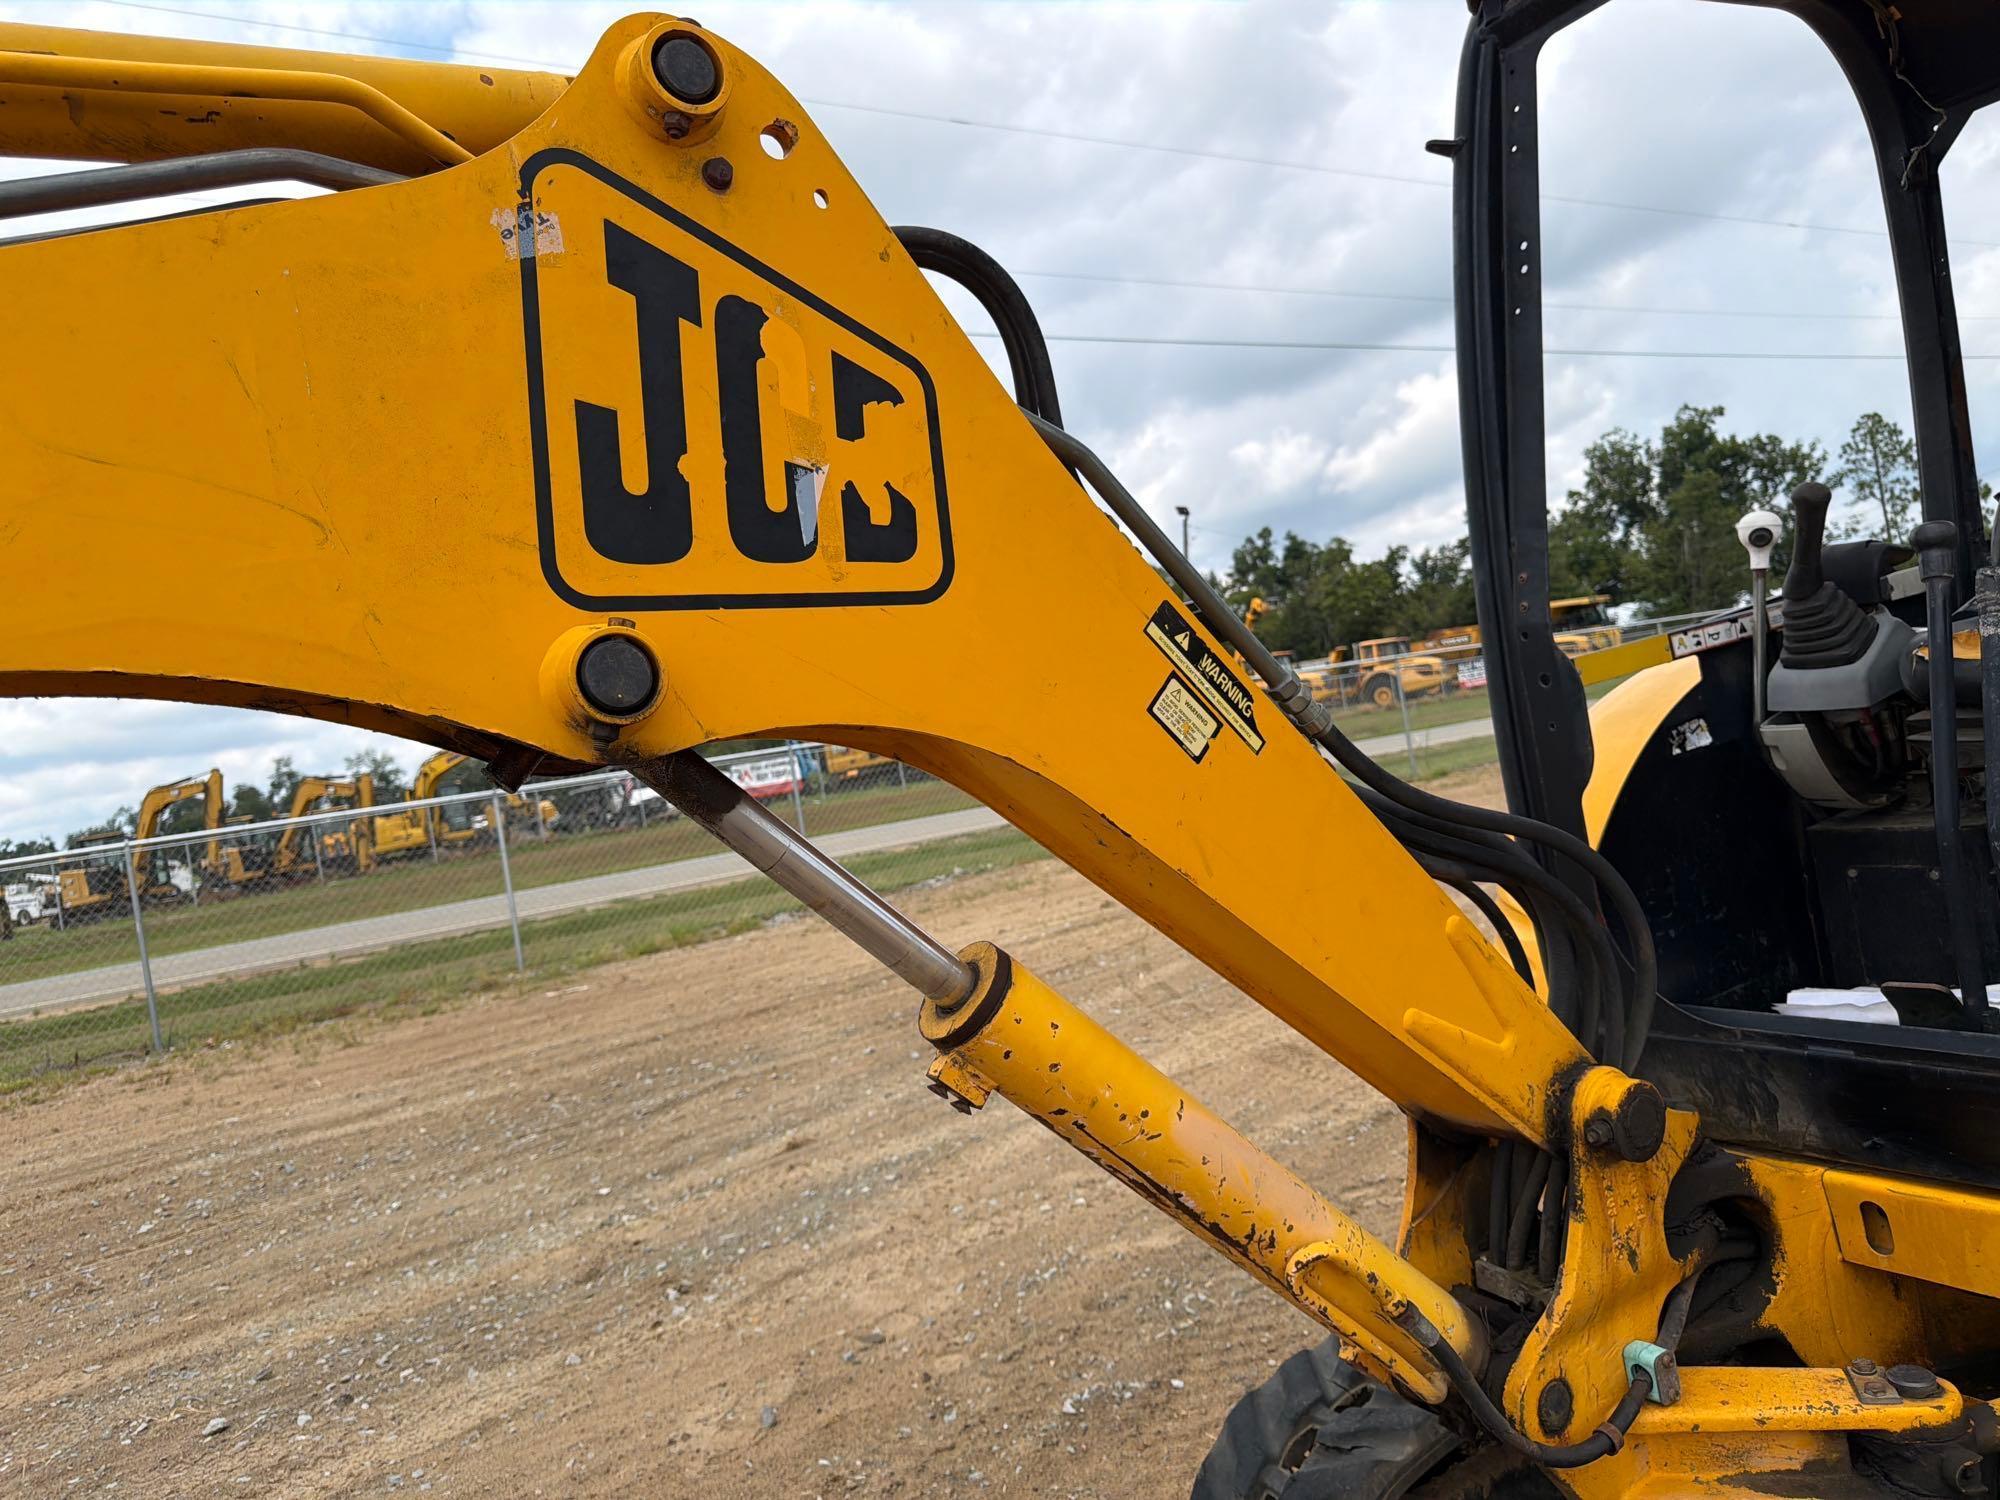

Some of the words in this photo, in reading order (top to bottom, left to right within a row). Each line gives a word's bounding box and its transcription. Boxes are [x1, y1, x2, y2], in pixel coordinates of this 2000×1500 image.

[575, 219, 917, 565] JCB
[1185, 699, 1208, 727] WARNING
[1201, 653, 1253, 718] WARNING
